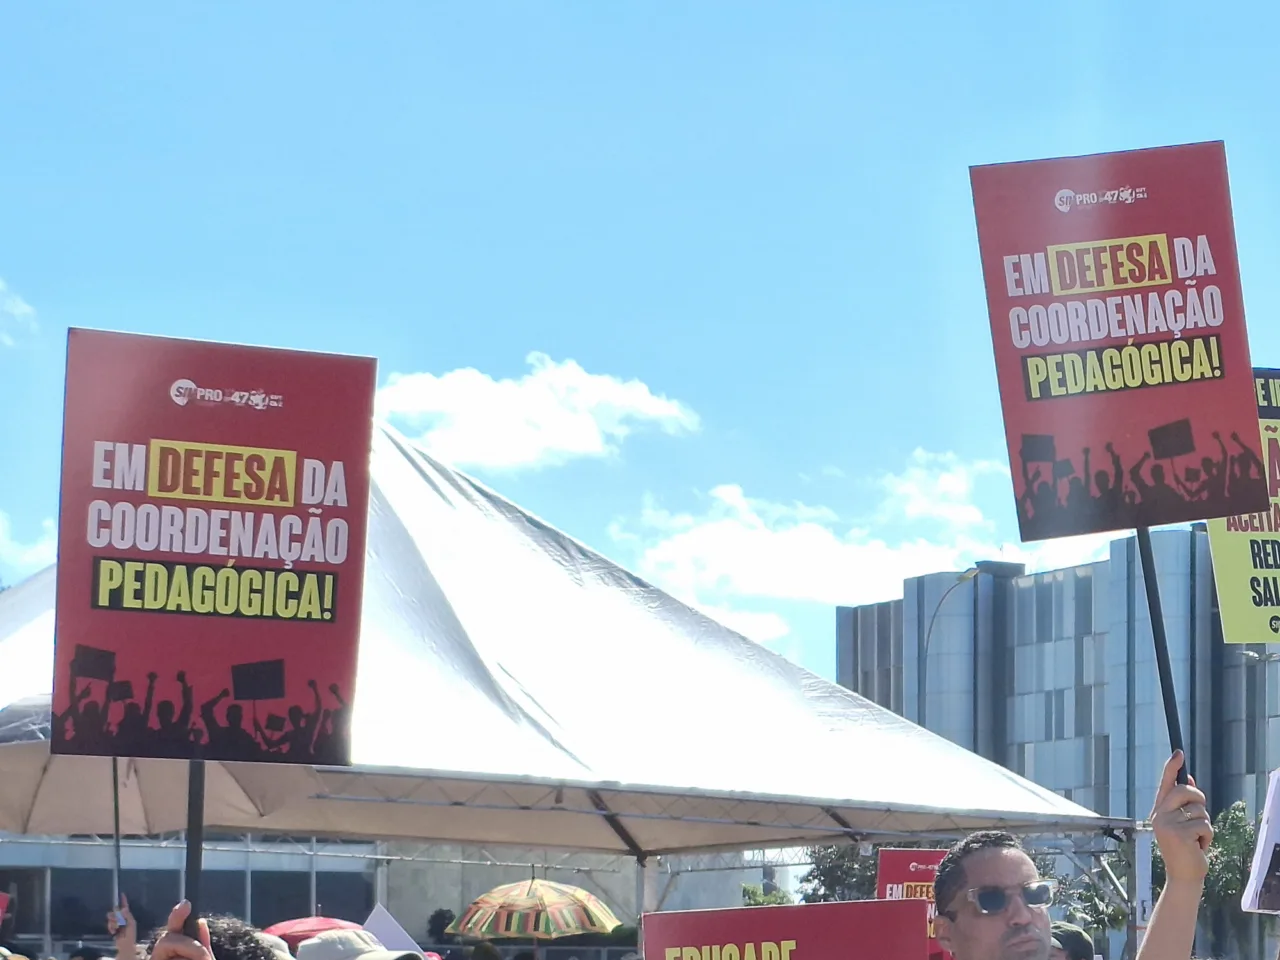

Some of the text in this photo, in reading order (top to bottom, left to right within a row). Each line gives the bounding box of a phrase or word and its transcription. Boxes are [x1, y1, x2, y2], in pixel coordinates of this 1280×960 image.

[1003, 235, 1217, 297] EM DEFESA DA
[1008, 280, 1224, 349] COORDENAÇÃO
[1026, 338, 1221, 399] PEDAGÓGICA!
[92, 441, 348, 507] EM DEFESA DA
[87, 500, 349, 569] COORDENAÇÃO
[97, 558, 334, 621] PEDAGÓGICA!
[886, 884, 903, 900] EM
